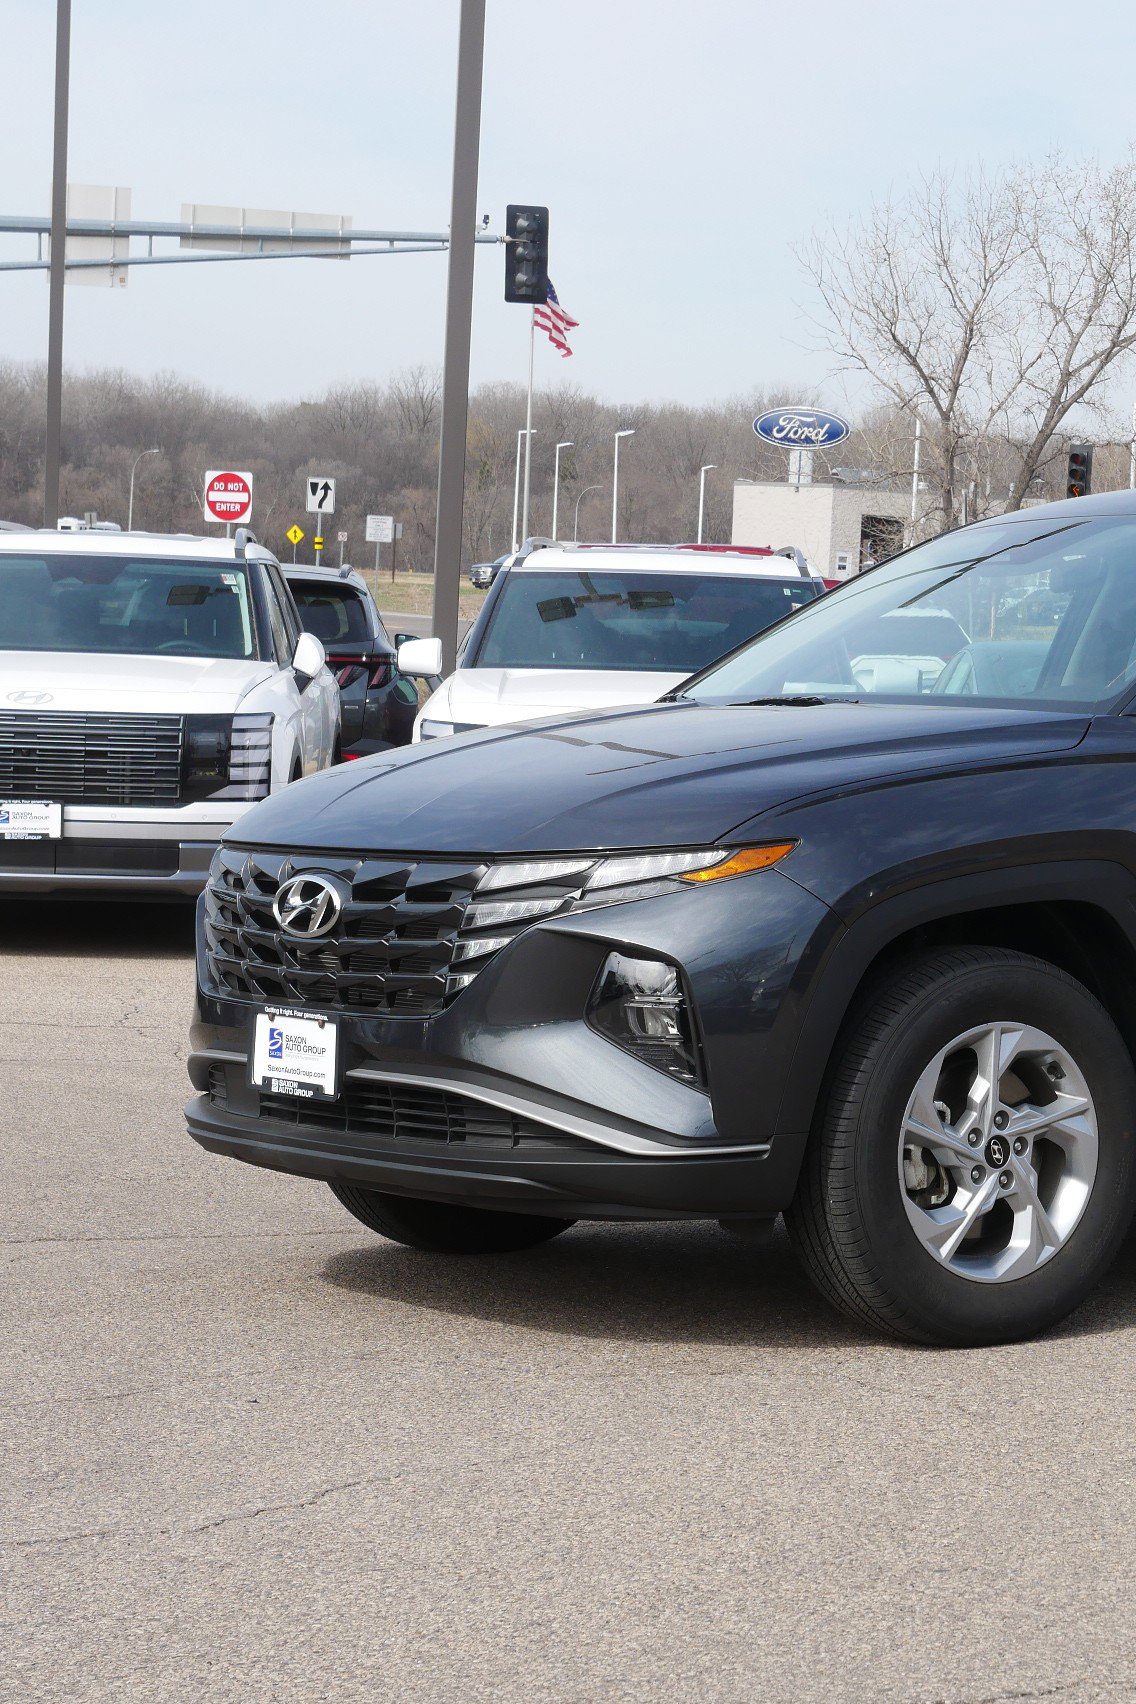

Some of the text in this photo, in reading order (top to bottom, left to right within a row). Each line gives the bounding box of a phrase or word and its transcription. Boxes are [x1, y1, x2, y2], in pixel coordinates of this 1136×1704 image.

[773, 415, 830, 440] Ford
[214, 482, 243, 491] DO NOT
[216, 503, 240, 511] ENTER
[265, 1006, 280, 1014] Getting
[285, 1034, 307, 1045] SAXON
[285, 1043, 327, 1055] AUTO GROUP
[279, 1079, 299, 1088] SAXON
[278, 1086, 314, 1097] AUTO GROUP
